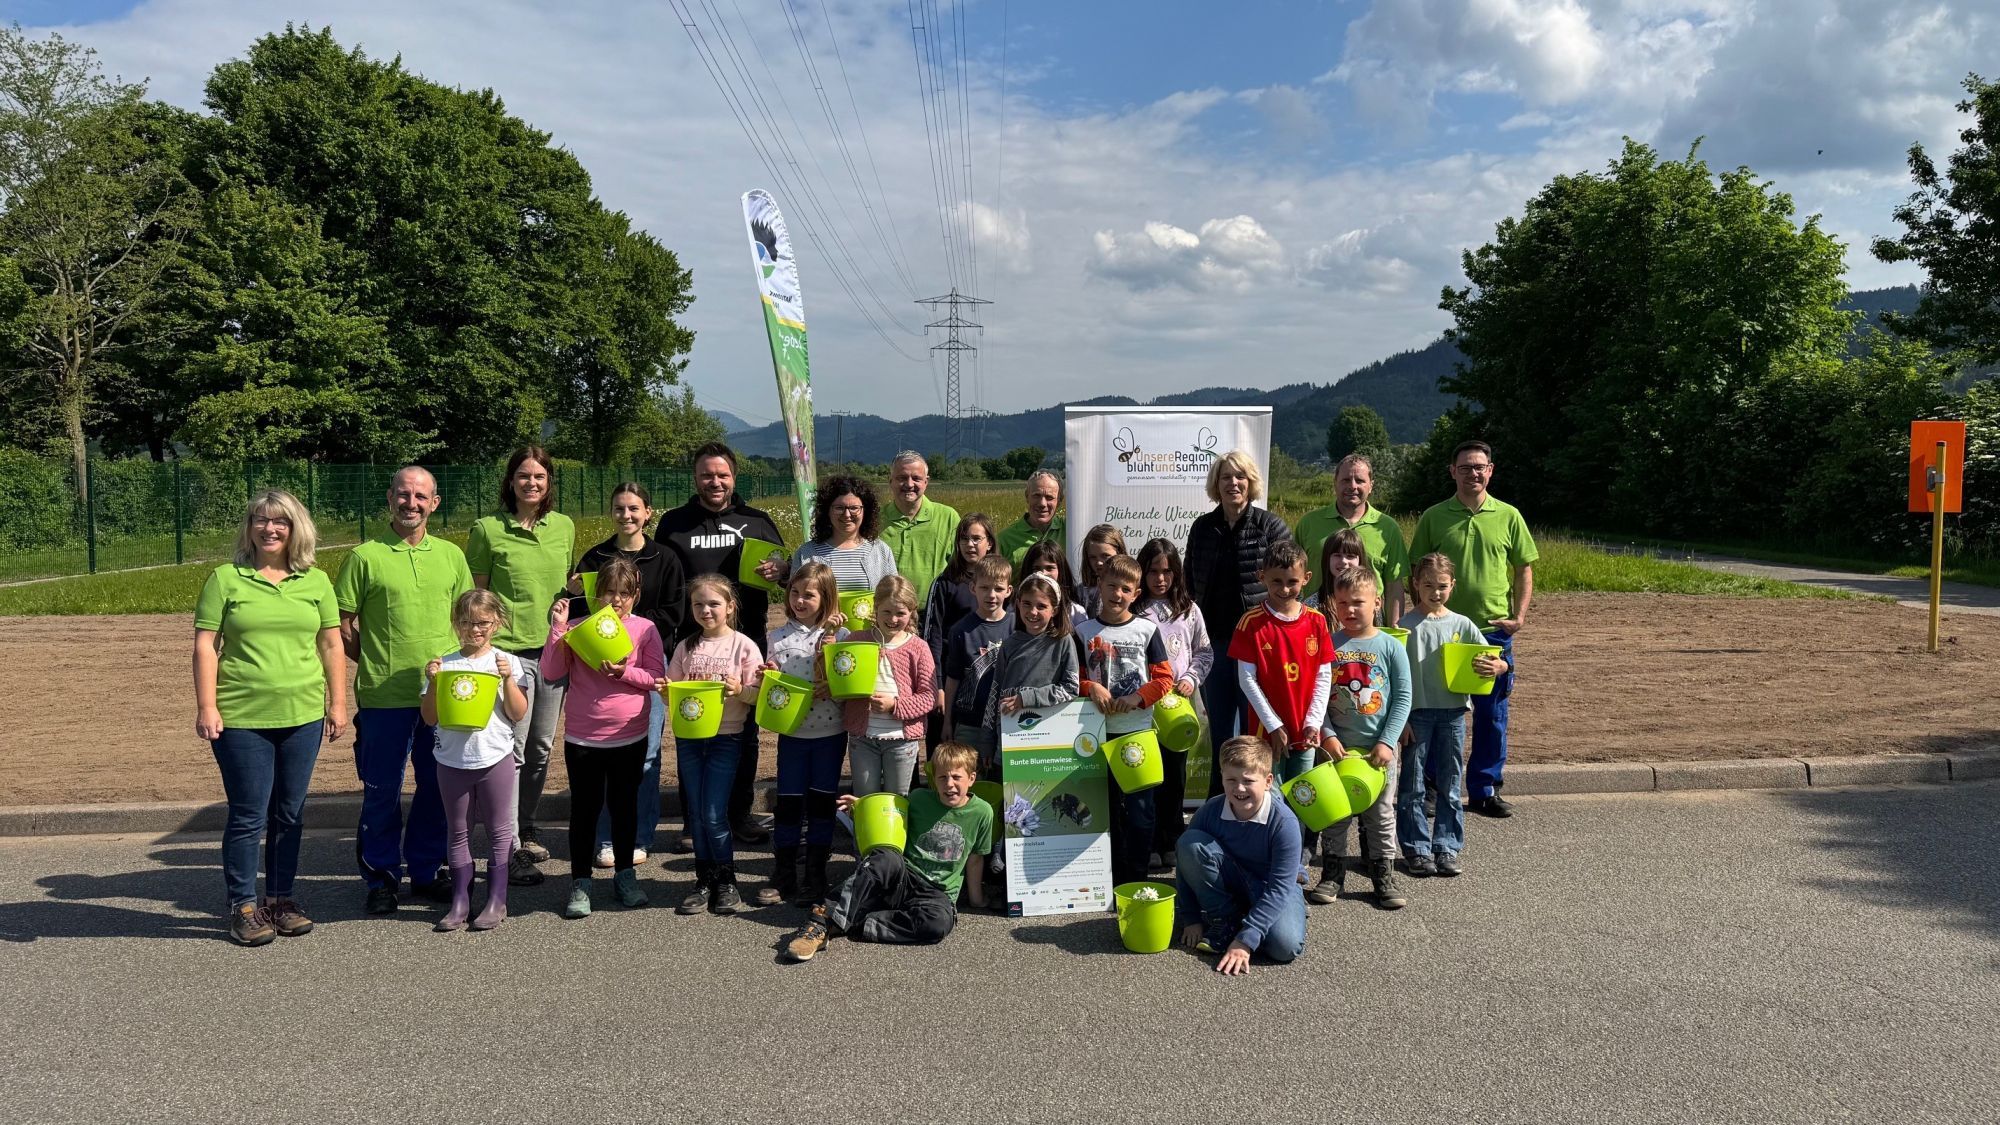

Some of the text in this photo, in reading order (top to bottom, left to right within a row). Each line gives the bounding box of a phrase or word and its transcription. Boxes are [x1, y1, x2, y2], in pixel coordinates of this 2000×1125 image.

[1136, 451, 1212, 465] UnsereRegion
[1105, 506, 1162, 522] Blühende
[690, 533, 736, 549] PUMA
[1119, 524, 1191, 542] rten für Wi
[1283, 661, 1299, 682] 19
[1030, 757, 1073, 766] Blumenwiese
[1043, 764, 1052, 772] für
[1053, 763, 1079, 772] blühende
